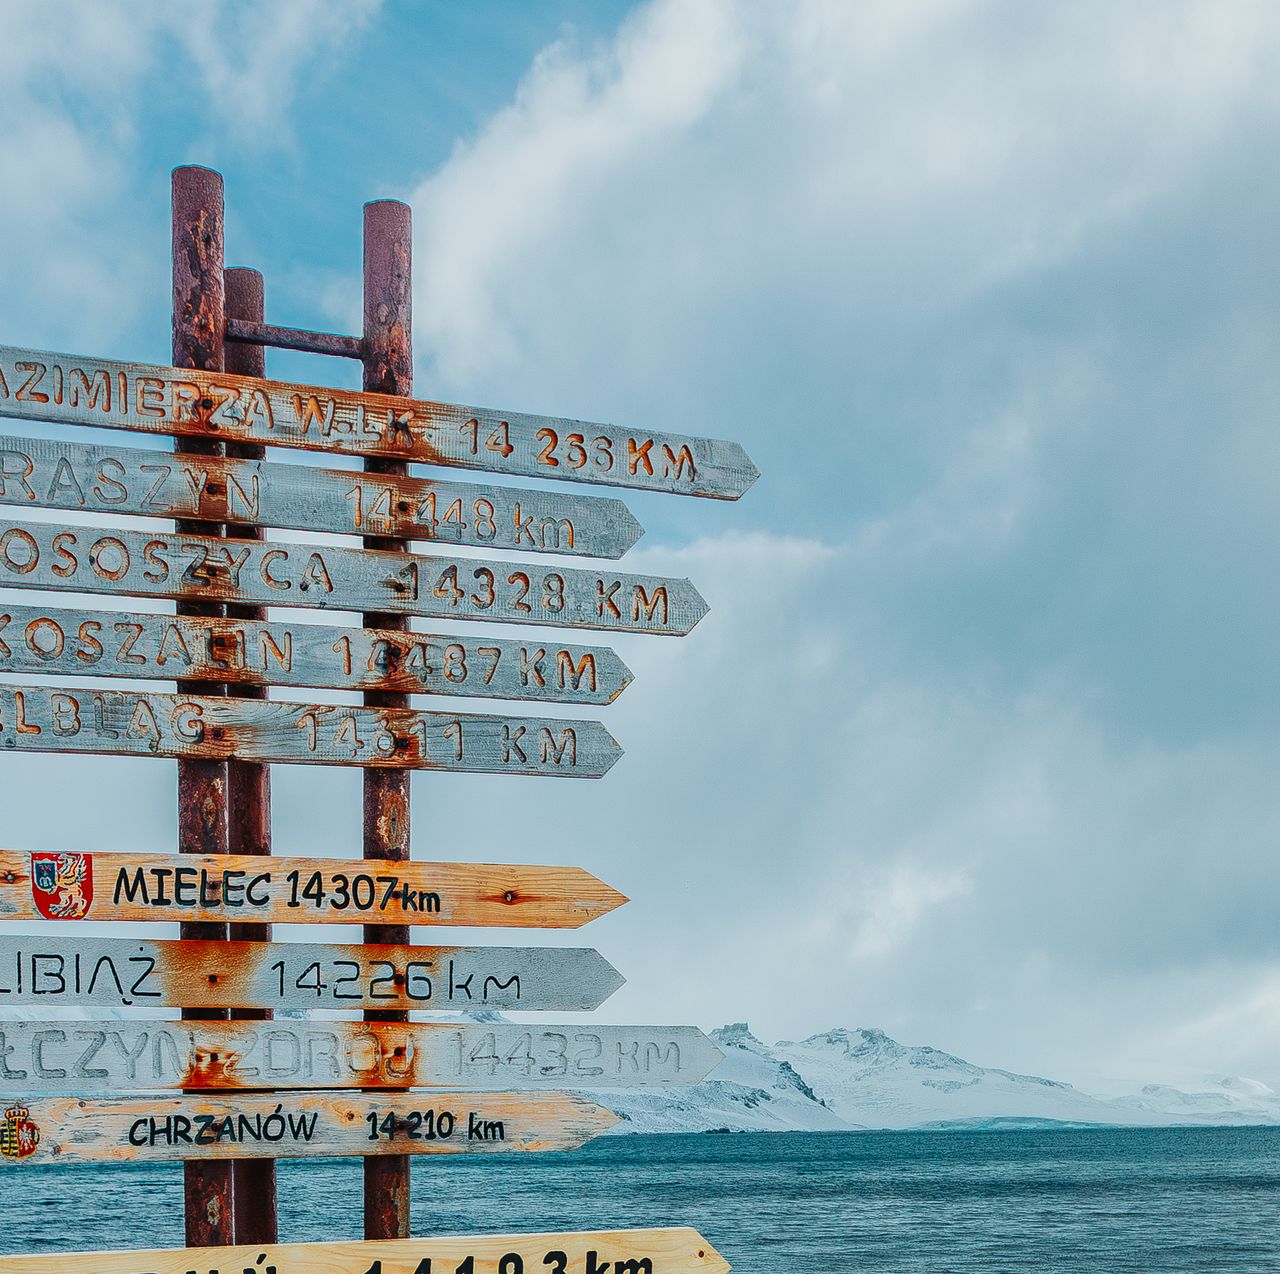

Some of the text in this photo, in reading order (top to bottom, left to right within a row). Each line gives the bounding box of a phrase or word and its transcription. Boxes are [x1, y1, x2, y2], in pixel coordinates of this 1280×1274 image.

[399, 562, 565, 613] 14328
[596, 579, 668, 625] KM
[331, 635, 502, 685] 14487
[520, 647, 597, 692] KM
[501, 724, 577, 766] KM
[113, 867, 272, 907] MIELEC
[128, 1104, 318, 1146] CHRZANÓW
[468, 1111, 505, 1141] km
